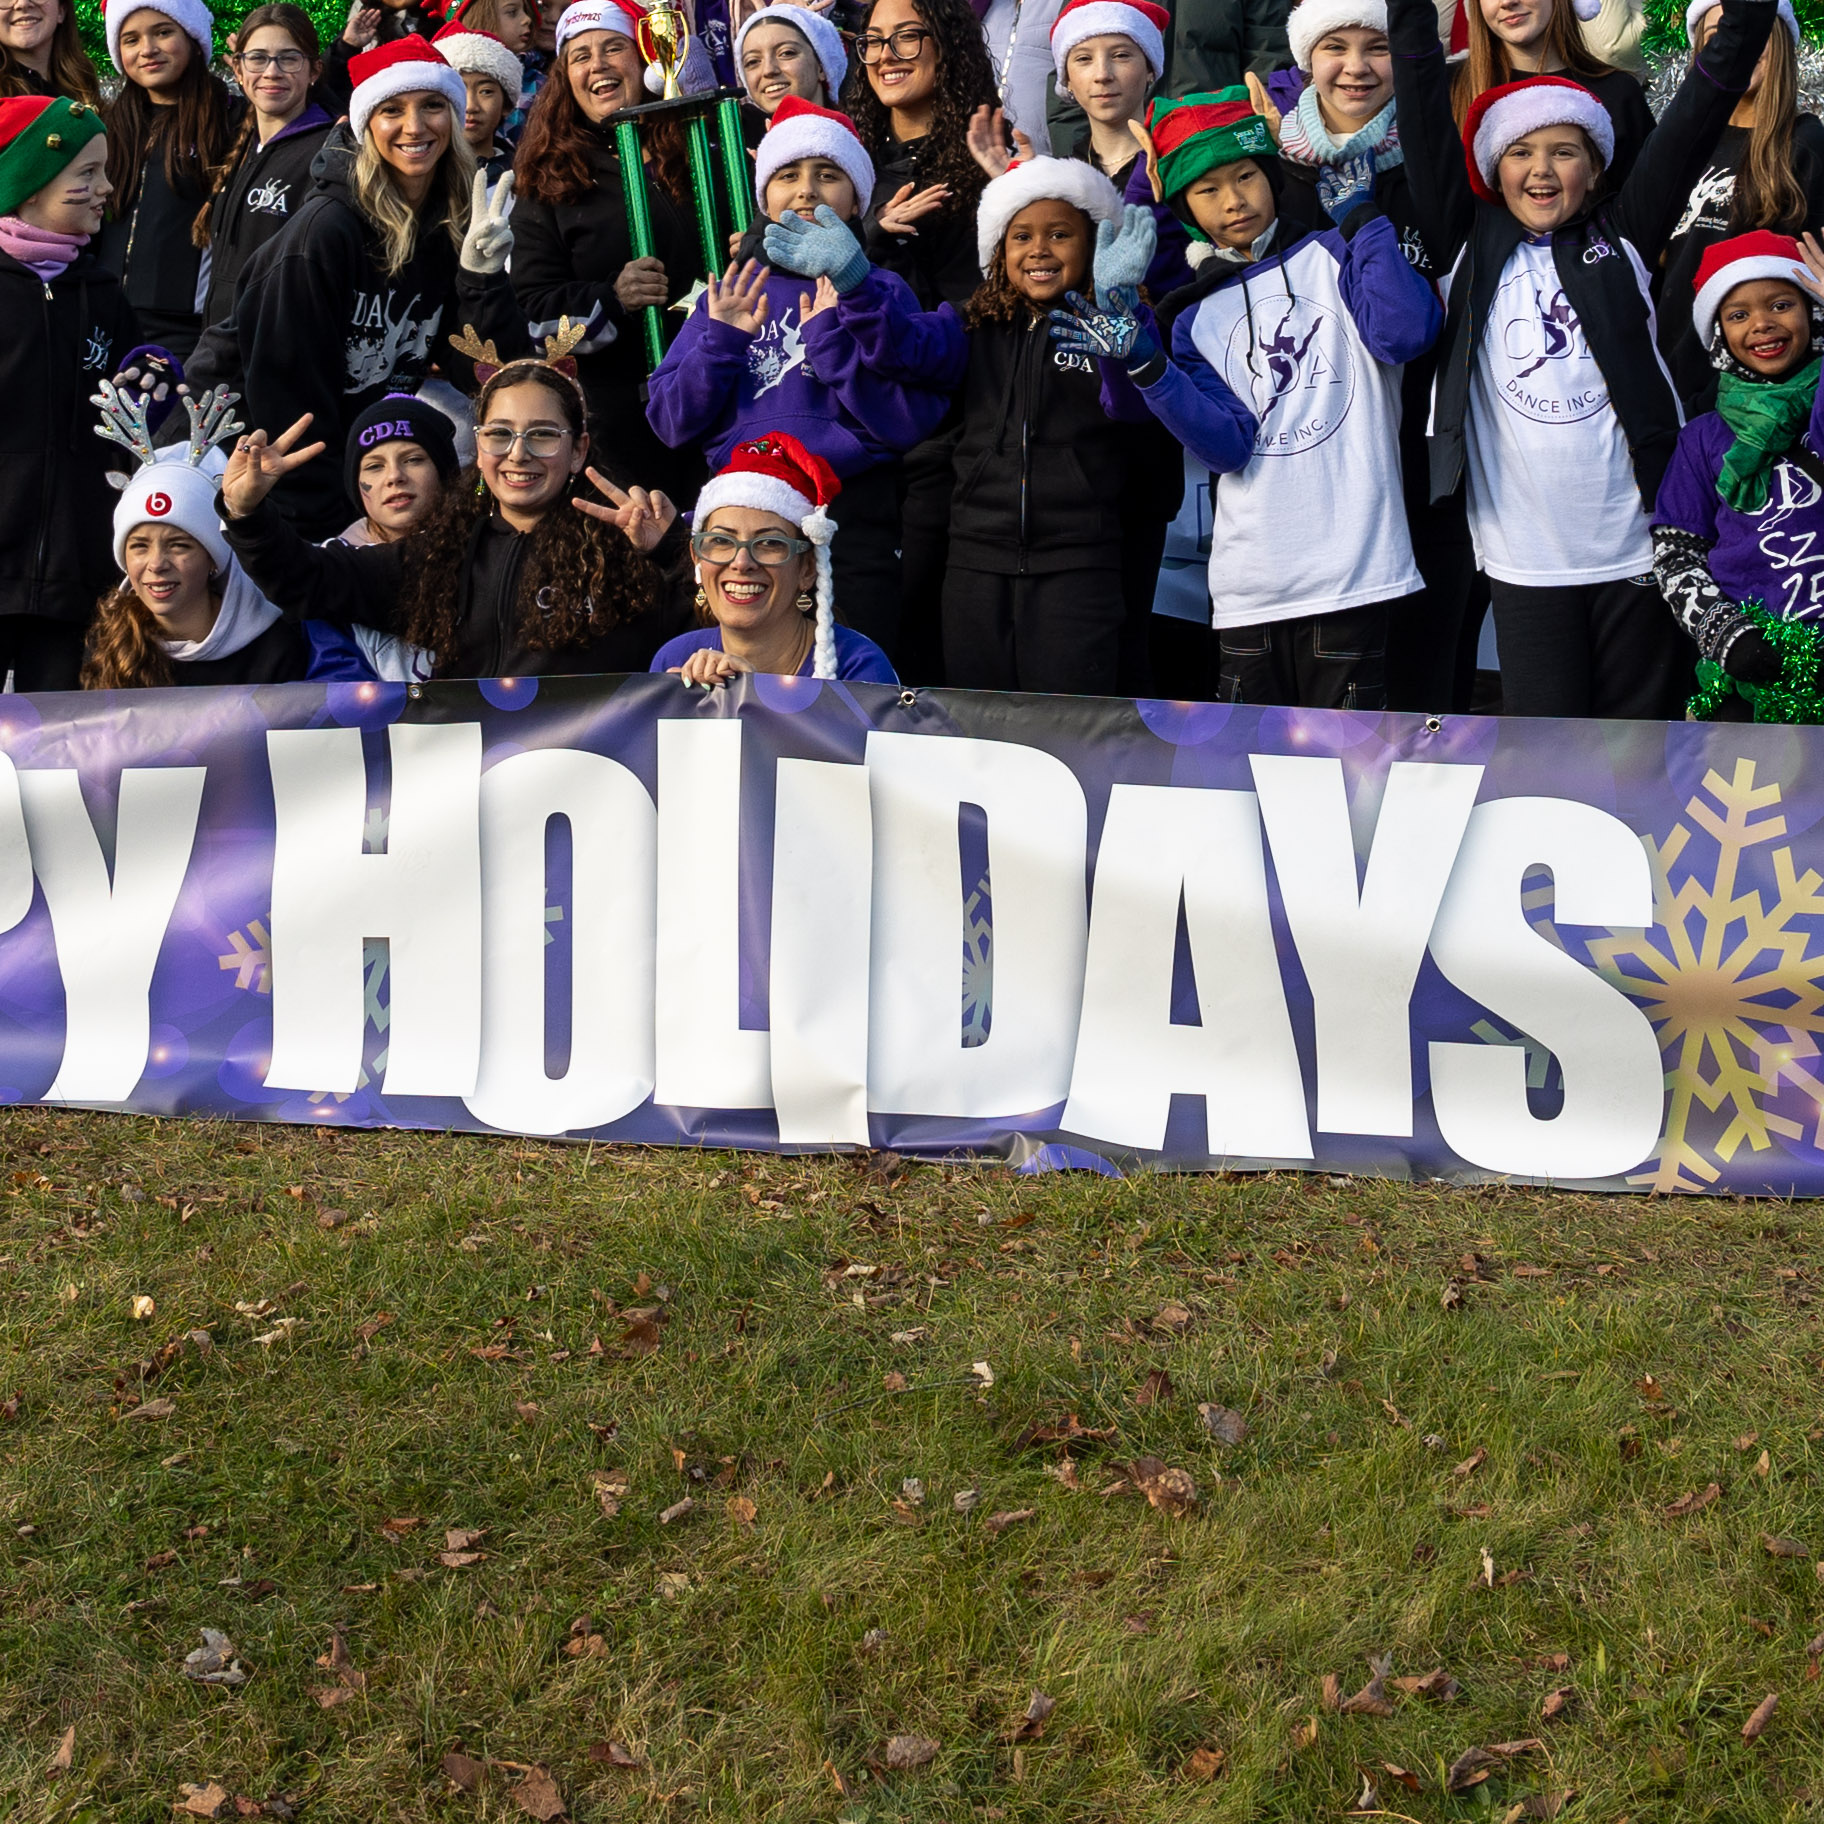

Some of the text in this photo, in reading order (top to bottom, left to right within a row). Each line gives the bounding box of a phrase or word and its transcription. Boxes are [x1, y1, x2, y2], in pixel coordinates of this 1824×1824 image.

[247, 187, 288, 213] CDA
[1504, 317, 1592, 360] CD
[1054, 351, 1094, 373] CDA
[1506, 379, 1602, 414] DANCE INC.
[358, 420, 415, 447] CDA
[1293, 419, 1329, 443] INC.
[263, 717, 1665, 1179] HOLIDAYS
